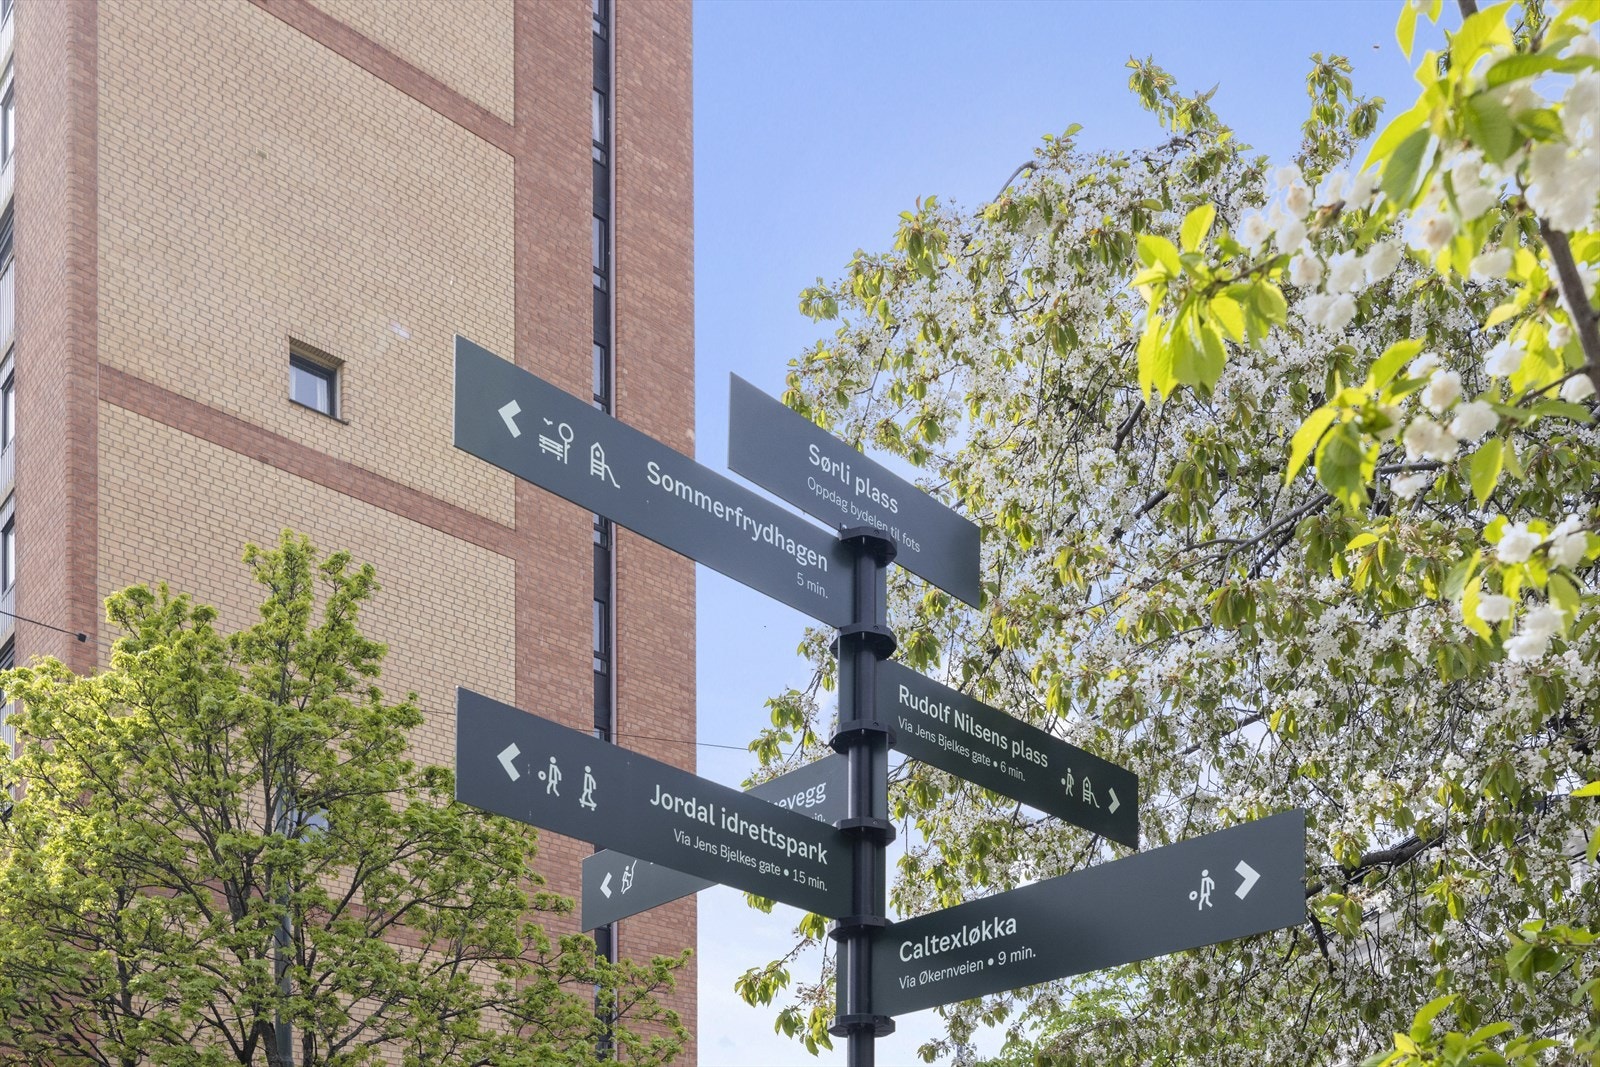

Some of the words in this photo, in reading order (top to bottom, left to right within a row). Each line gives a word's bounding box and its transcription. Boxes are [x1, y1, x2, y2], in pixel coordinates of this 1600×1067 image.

[809, 443, 851, 486] Sørli
[855, 476, 899, 514] plass
[647, 461, 828, 572] Sommerfrydhagen
[807, 476, 849, 513] Oppdag
[850, 501, 889, 532] bydelen
[890, 527, 901, 542] til
[902, 532, 921, 553] fots
[797, 572, 804, 586] 5
[807, 580, 829, 599] min.
[898, 715, 914, 733] Via
[915, 725, 937, 743] Jens
[938, 733, 971, 758] Bjelkes
[971, 750, 992, 767] gate
[1000, 761, 1007, 774] 6
[1008, 766, 1026, 782] min.
[899, 684, 951, 724] Rudolf
[954, 709, 1008, 750] Nilsens
[1012, 739, 1049, 768] plass
[650, 784, 716, 827] Jordal
[721, 807, 828, 865] idrettspark
[774, 782, 827, 810] evegg
[673, 828, 691, 847] Via
[693, 836, 718, 855] Jens
[720, 844, 757, 868] Bjelkes
[759, 859, 781, 875] gate
[792, 869, 806, 884] 15
[808, 876, 828, 892] min.
[898, 975, 916, 990] Via
[918, 959, 984, 985] Økernveien
[998, 951, 1006, 966] 9
[1010, 946, 1037, 964] min.
[899, 916, 1018, 963] Caltexløkka
